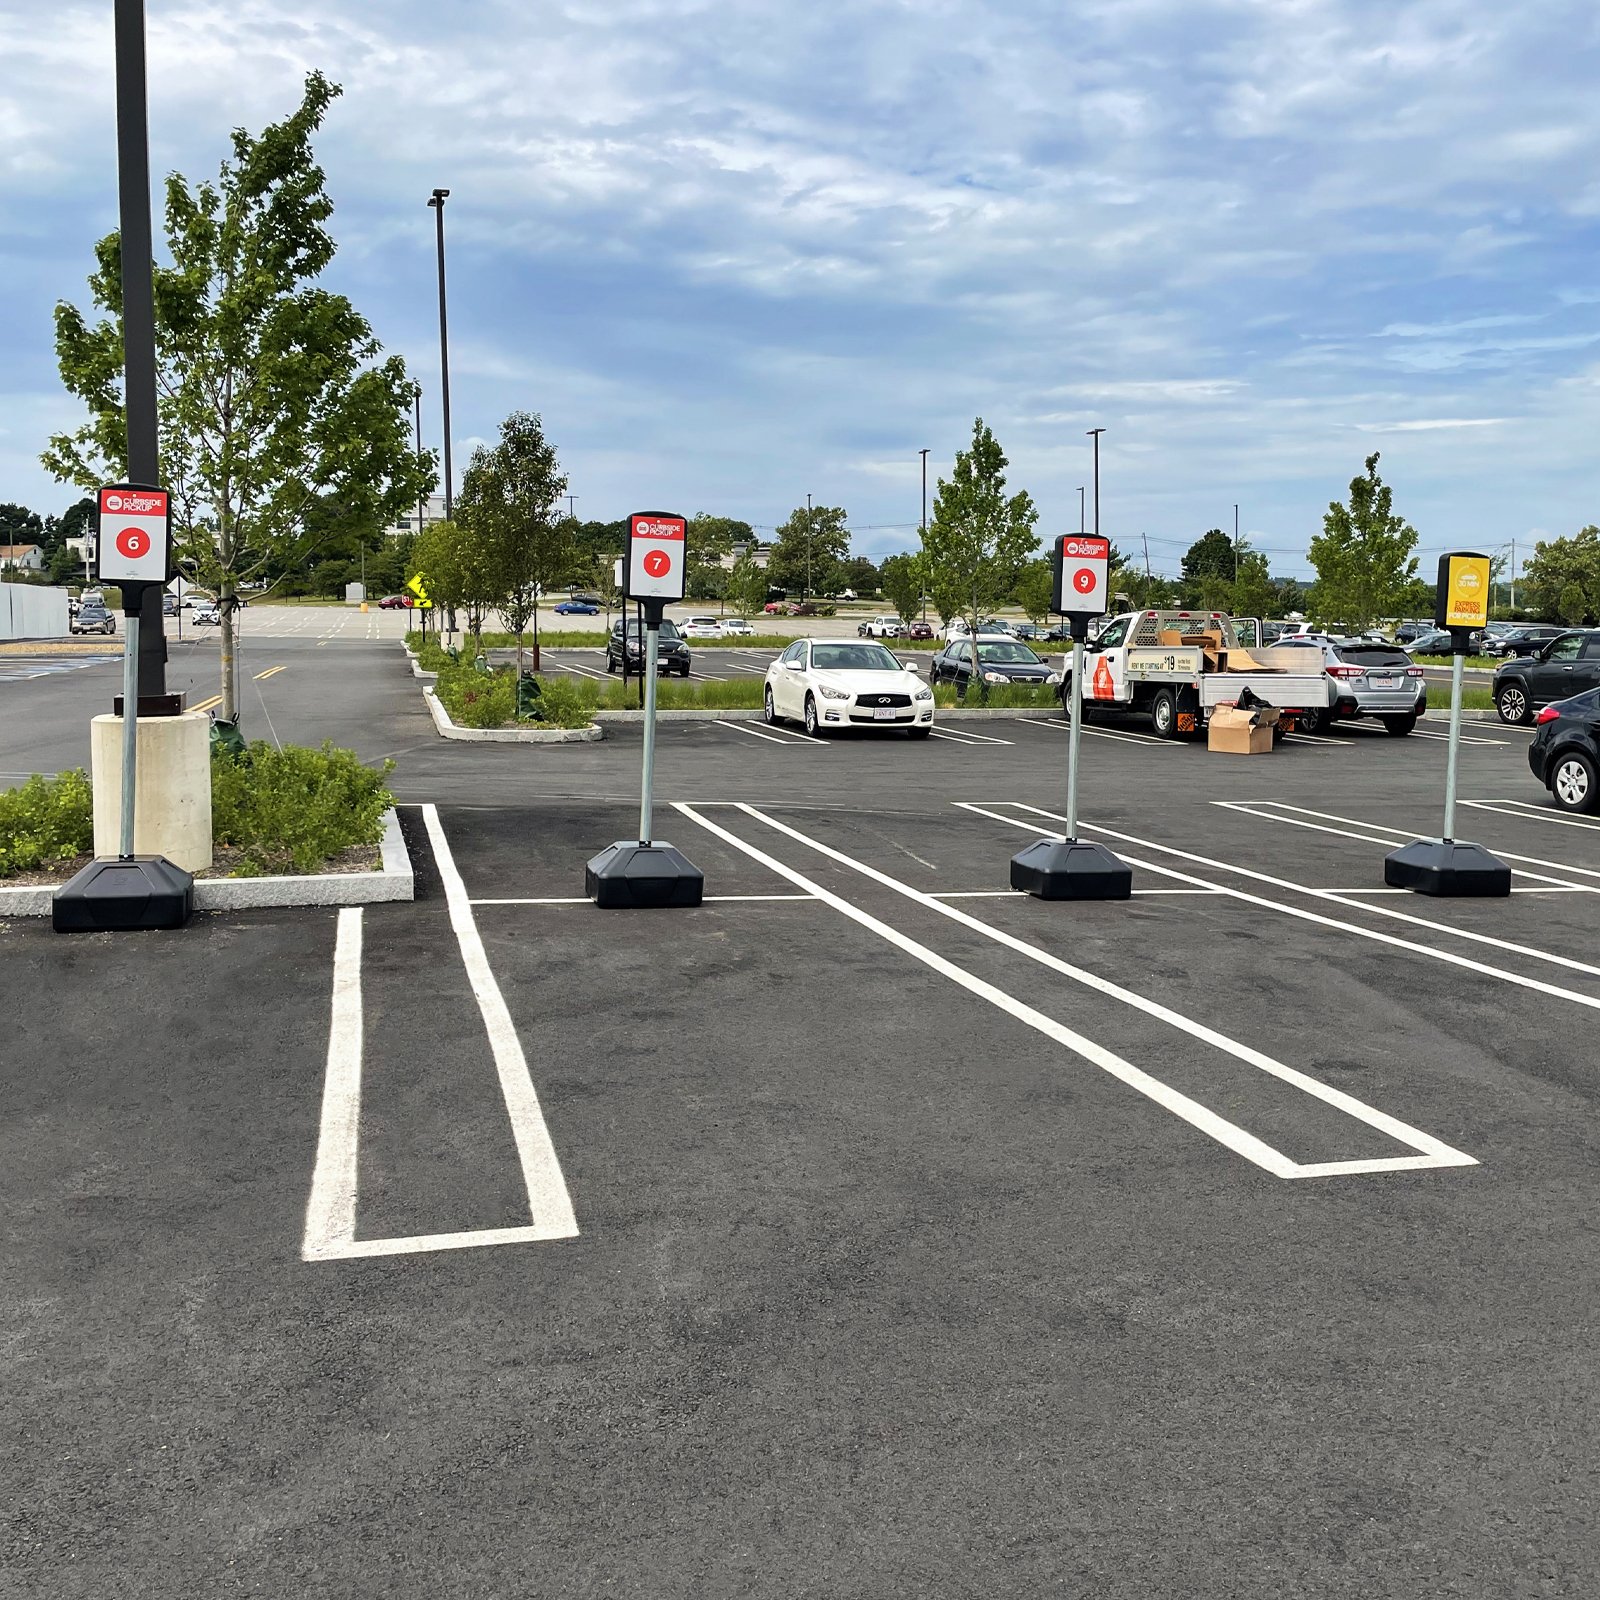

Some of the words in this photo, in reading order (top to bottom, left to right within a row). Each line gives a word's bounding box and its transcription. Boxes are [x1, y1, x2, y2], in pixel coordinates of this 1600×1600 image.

[123, 498, 162, 506] CURBSIDE
[123, 504, 153, 512] PICKUP
[650, 524, 681, 532] CURBSIDE
[127, 536, 140, 550] 6
[652, 558, 662, 570] 7
[1080, 575, 1089, 587] 9
